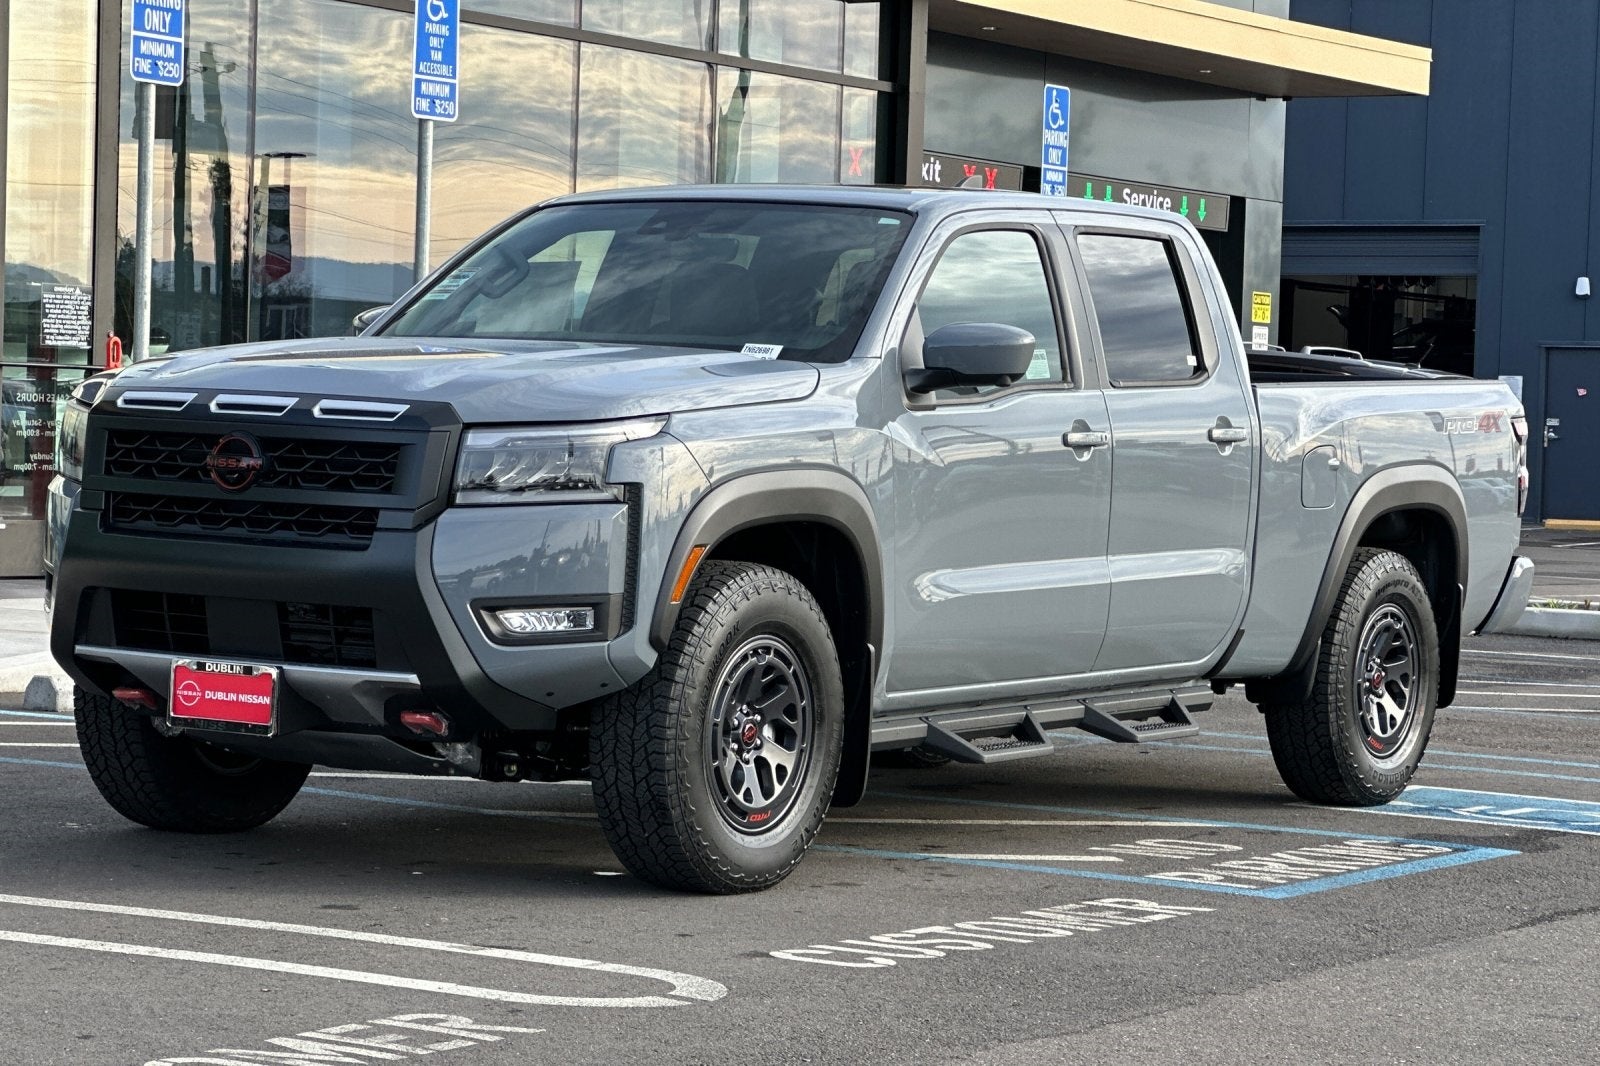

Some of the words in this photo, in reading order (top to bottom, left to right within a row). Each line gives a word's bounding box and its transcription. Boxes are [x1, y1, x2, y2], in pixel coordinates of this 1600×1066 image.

[144, 8, 171, 33] ONLY
[425, 22, 449, 36] PARKING
[140, 40, 174, 58] MINIMUM
[429, 36, 444, 48] ONLY
[431, 50, 442, 61] VAN
[134, 57, 152, 74] FINE
[156, 60, 179, 78] $250
[419, 62, 452, 76] ACCESSIBLE
[421, 82, 450, 97] MINIMUM
[415, 97, 430, 112] FINE
[434, 99, 454, 115] $250
[1045, 129, 1067, 147] PARKING
[1048, 148, 1062, 165] ONLY
[922, 157, 941, 182] xit
[1122, 188, 1171, 211] Service
[207, 456, 261, 469] NISSAN
[205, 662, 244, 674] DUBLIN
[176, 689, 202, 697] NISSAN
[205, 690, 237, 702] DUBLIN
[238, 694, 271, 705] NISSAN
[1087, 838, 1244, 860] NO
[1144, 839, 1453, 890] PARKING
[769, 898, 1217, 968] CUSTOMER
